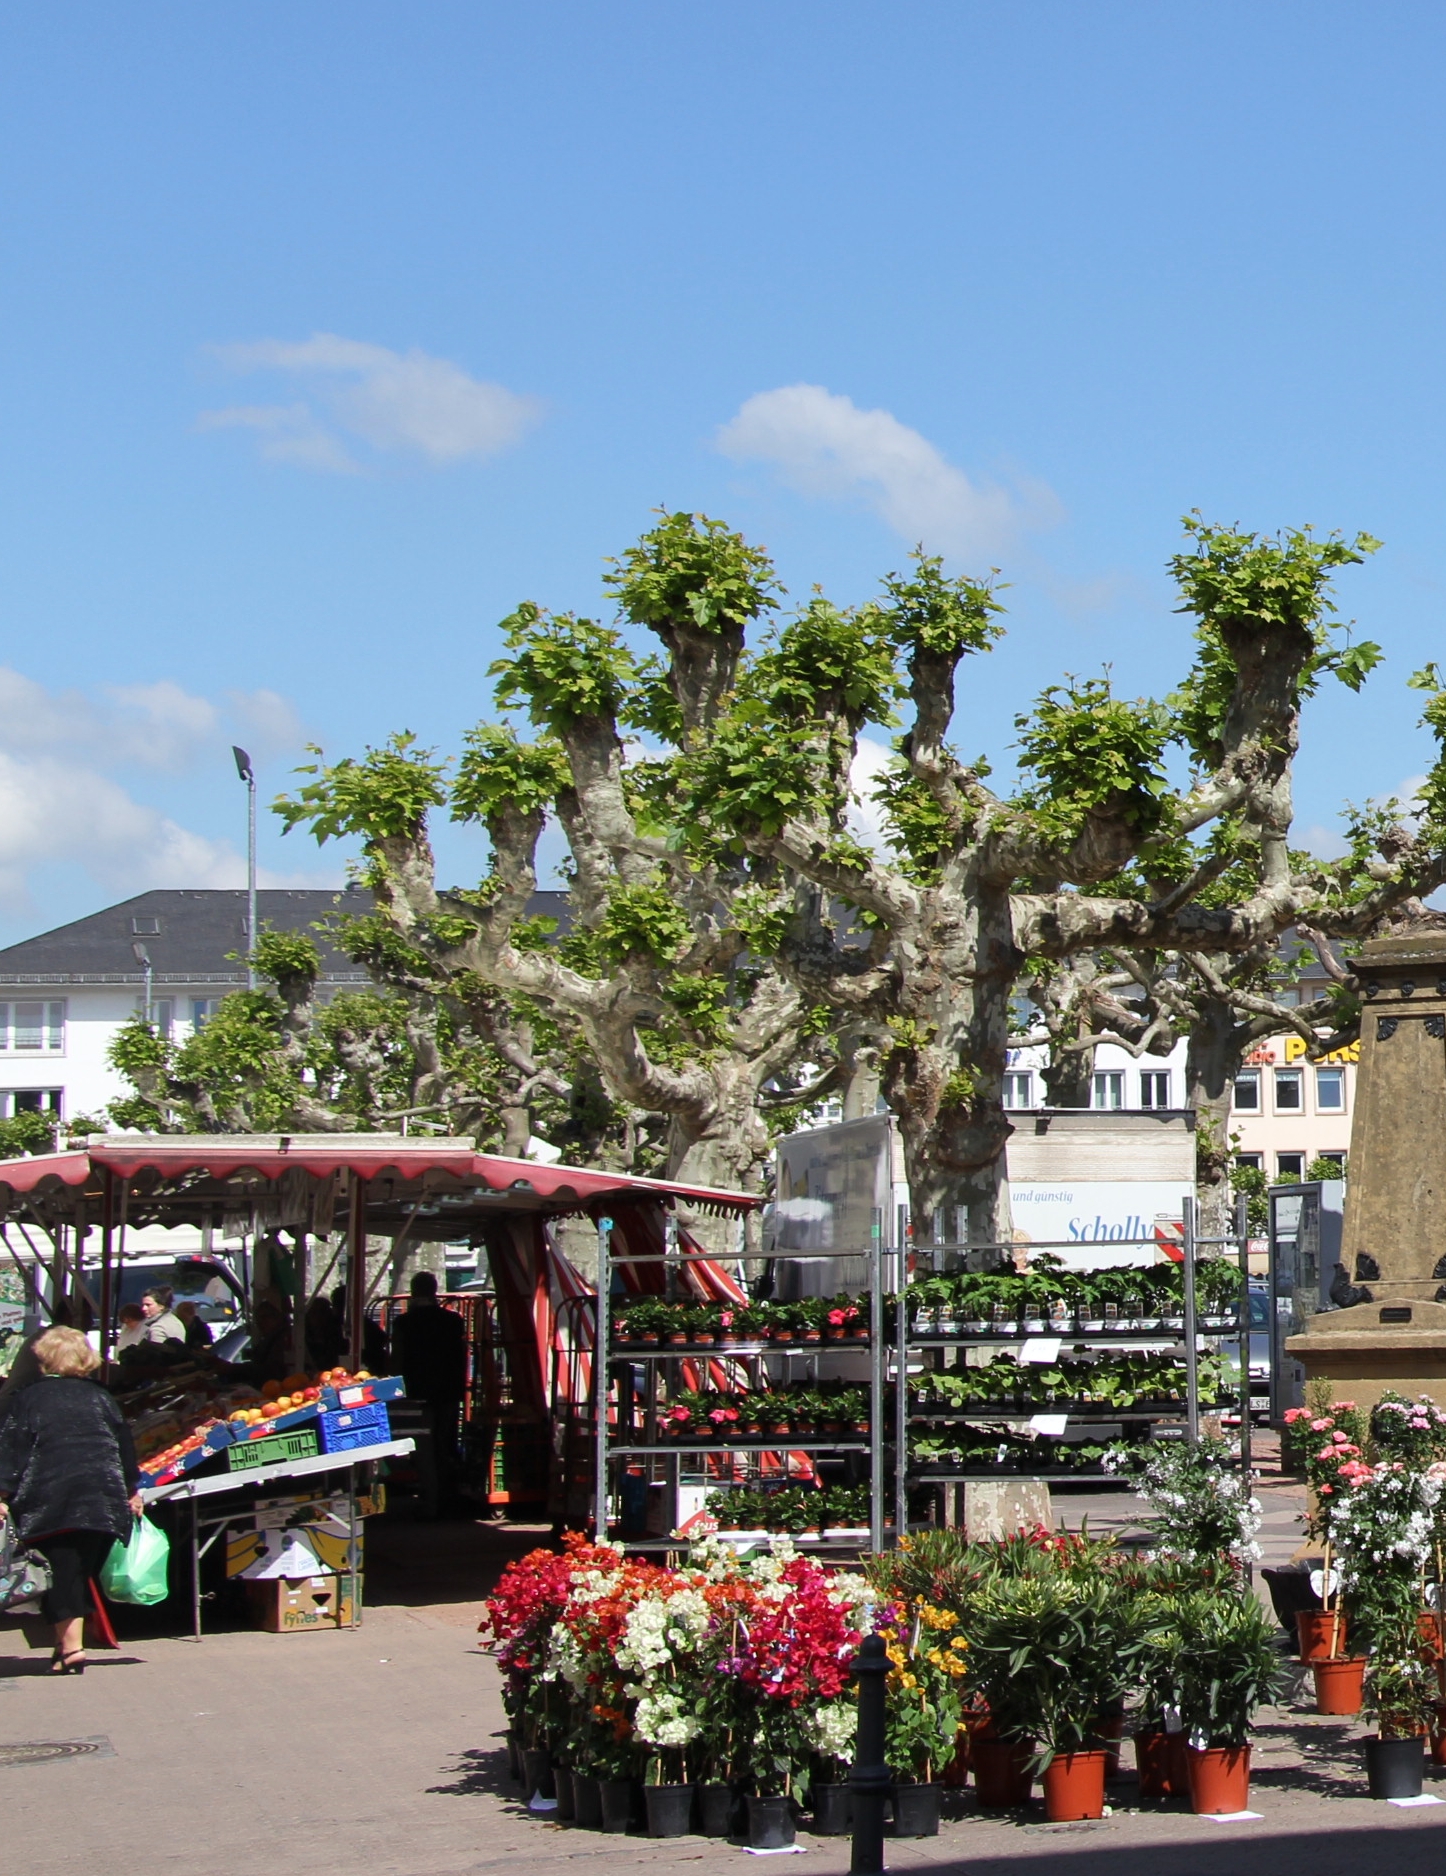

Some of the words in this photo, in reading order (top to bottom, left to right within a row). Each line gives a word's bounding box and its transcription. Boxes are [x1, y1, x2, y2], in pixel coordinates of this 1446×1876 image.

[1012, 1190, 1034, 1202] und
[1034, 1191, 1074, 1204] günstig
[1067, 1215, 1155, 1250] Scholly
